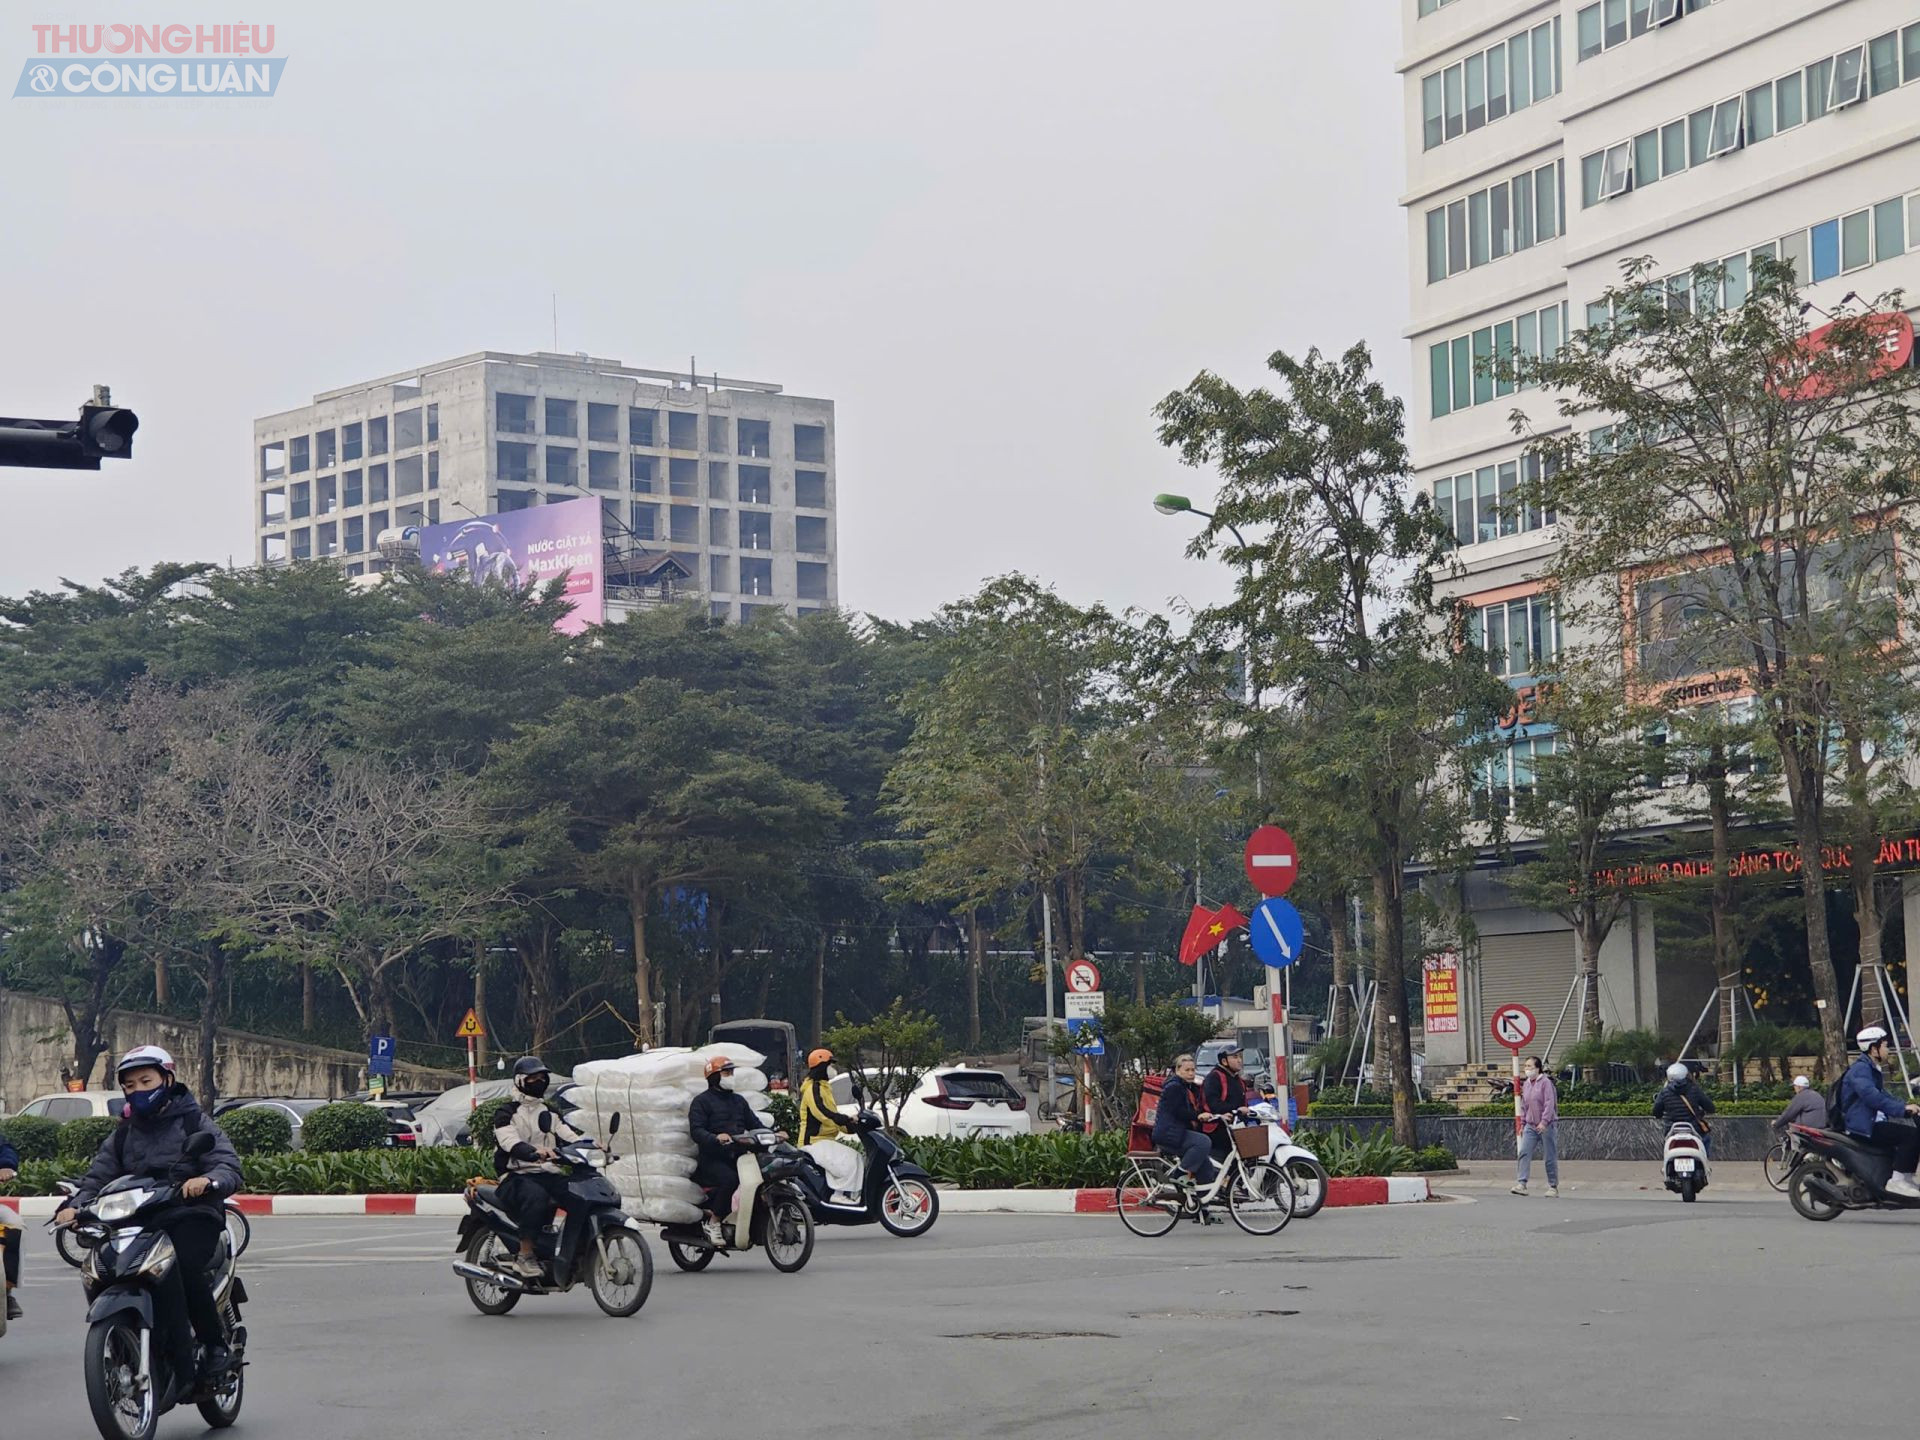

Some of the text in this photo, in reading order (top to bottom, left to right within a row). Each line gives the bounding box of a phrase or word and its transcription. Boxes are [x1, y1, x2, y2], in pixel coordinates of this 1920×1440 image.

[528, 536, 554, 554] NƯỚC
[528, 553, 593, 572] MaxKleen
[1773, 845, 1804, 872] TOÀ
[378, 1039, 388, 1055] P
